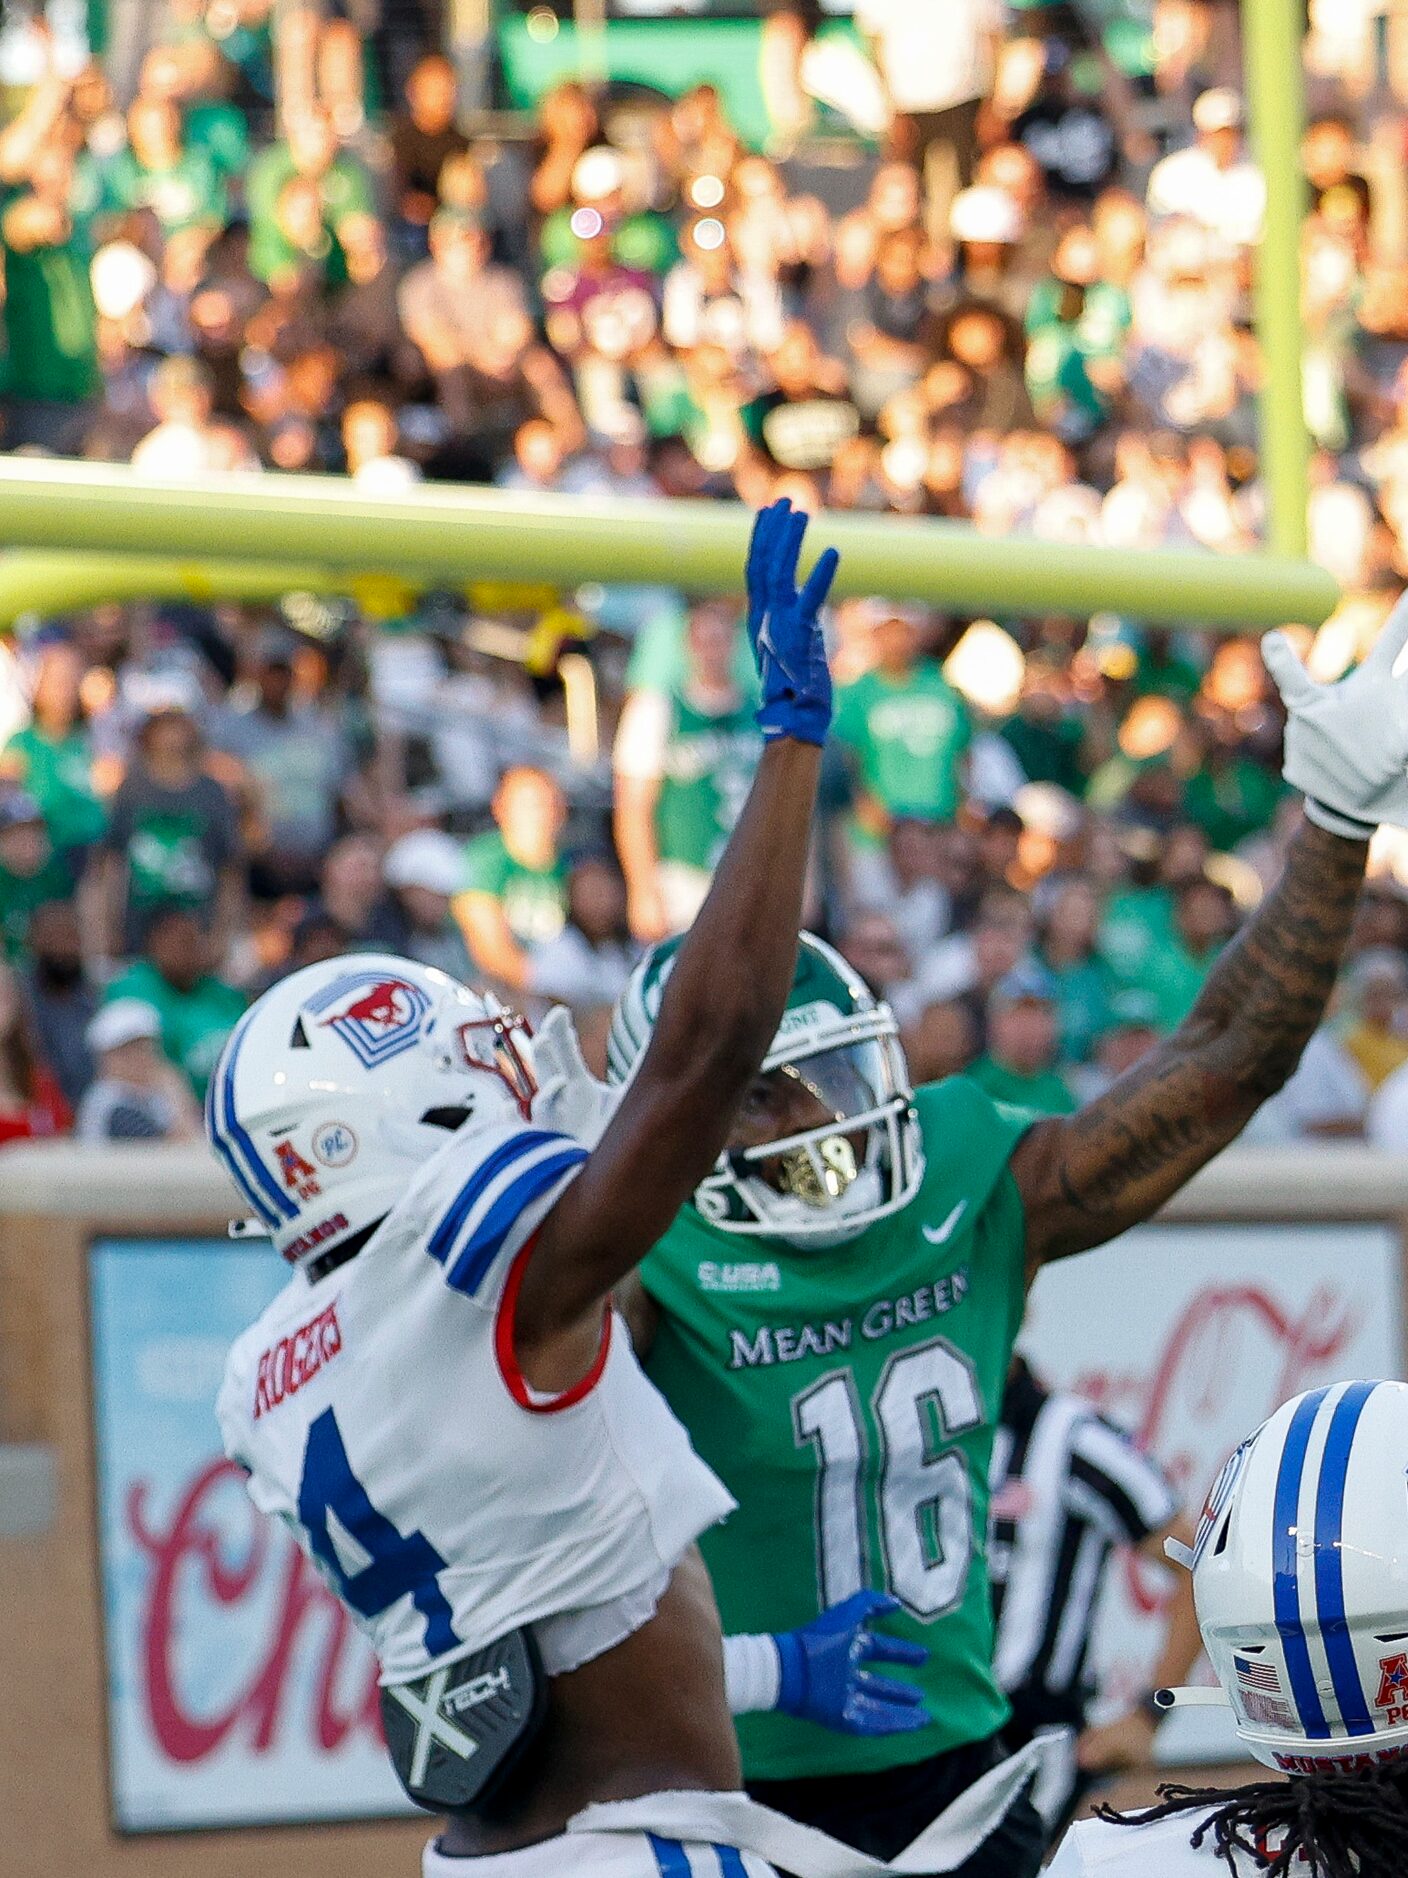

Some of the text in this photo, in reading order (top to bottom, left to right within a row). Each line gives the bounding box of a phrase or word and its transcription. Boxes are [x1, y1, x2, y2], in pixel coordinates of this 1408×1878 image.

[252, 1295, 342, 1420] ROGERS
[729, 1267, 969, 1369] MEAN GREEN
[297, 1403, 464, 1657] 4
[791, 1335, 983, 1624] 16
